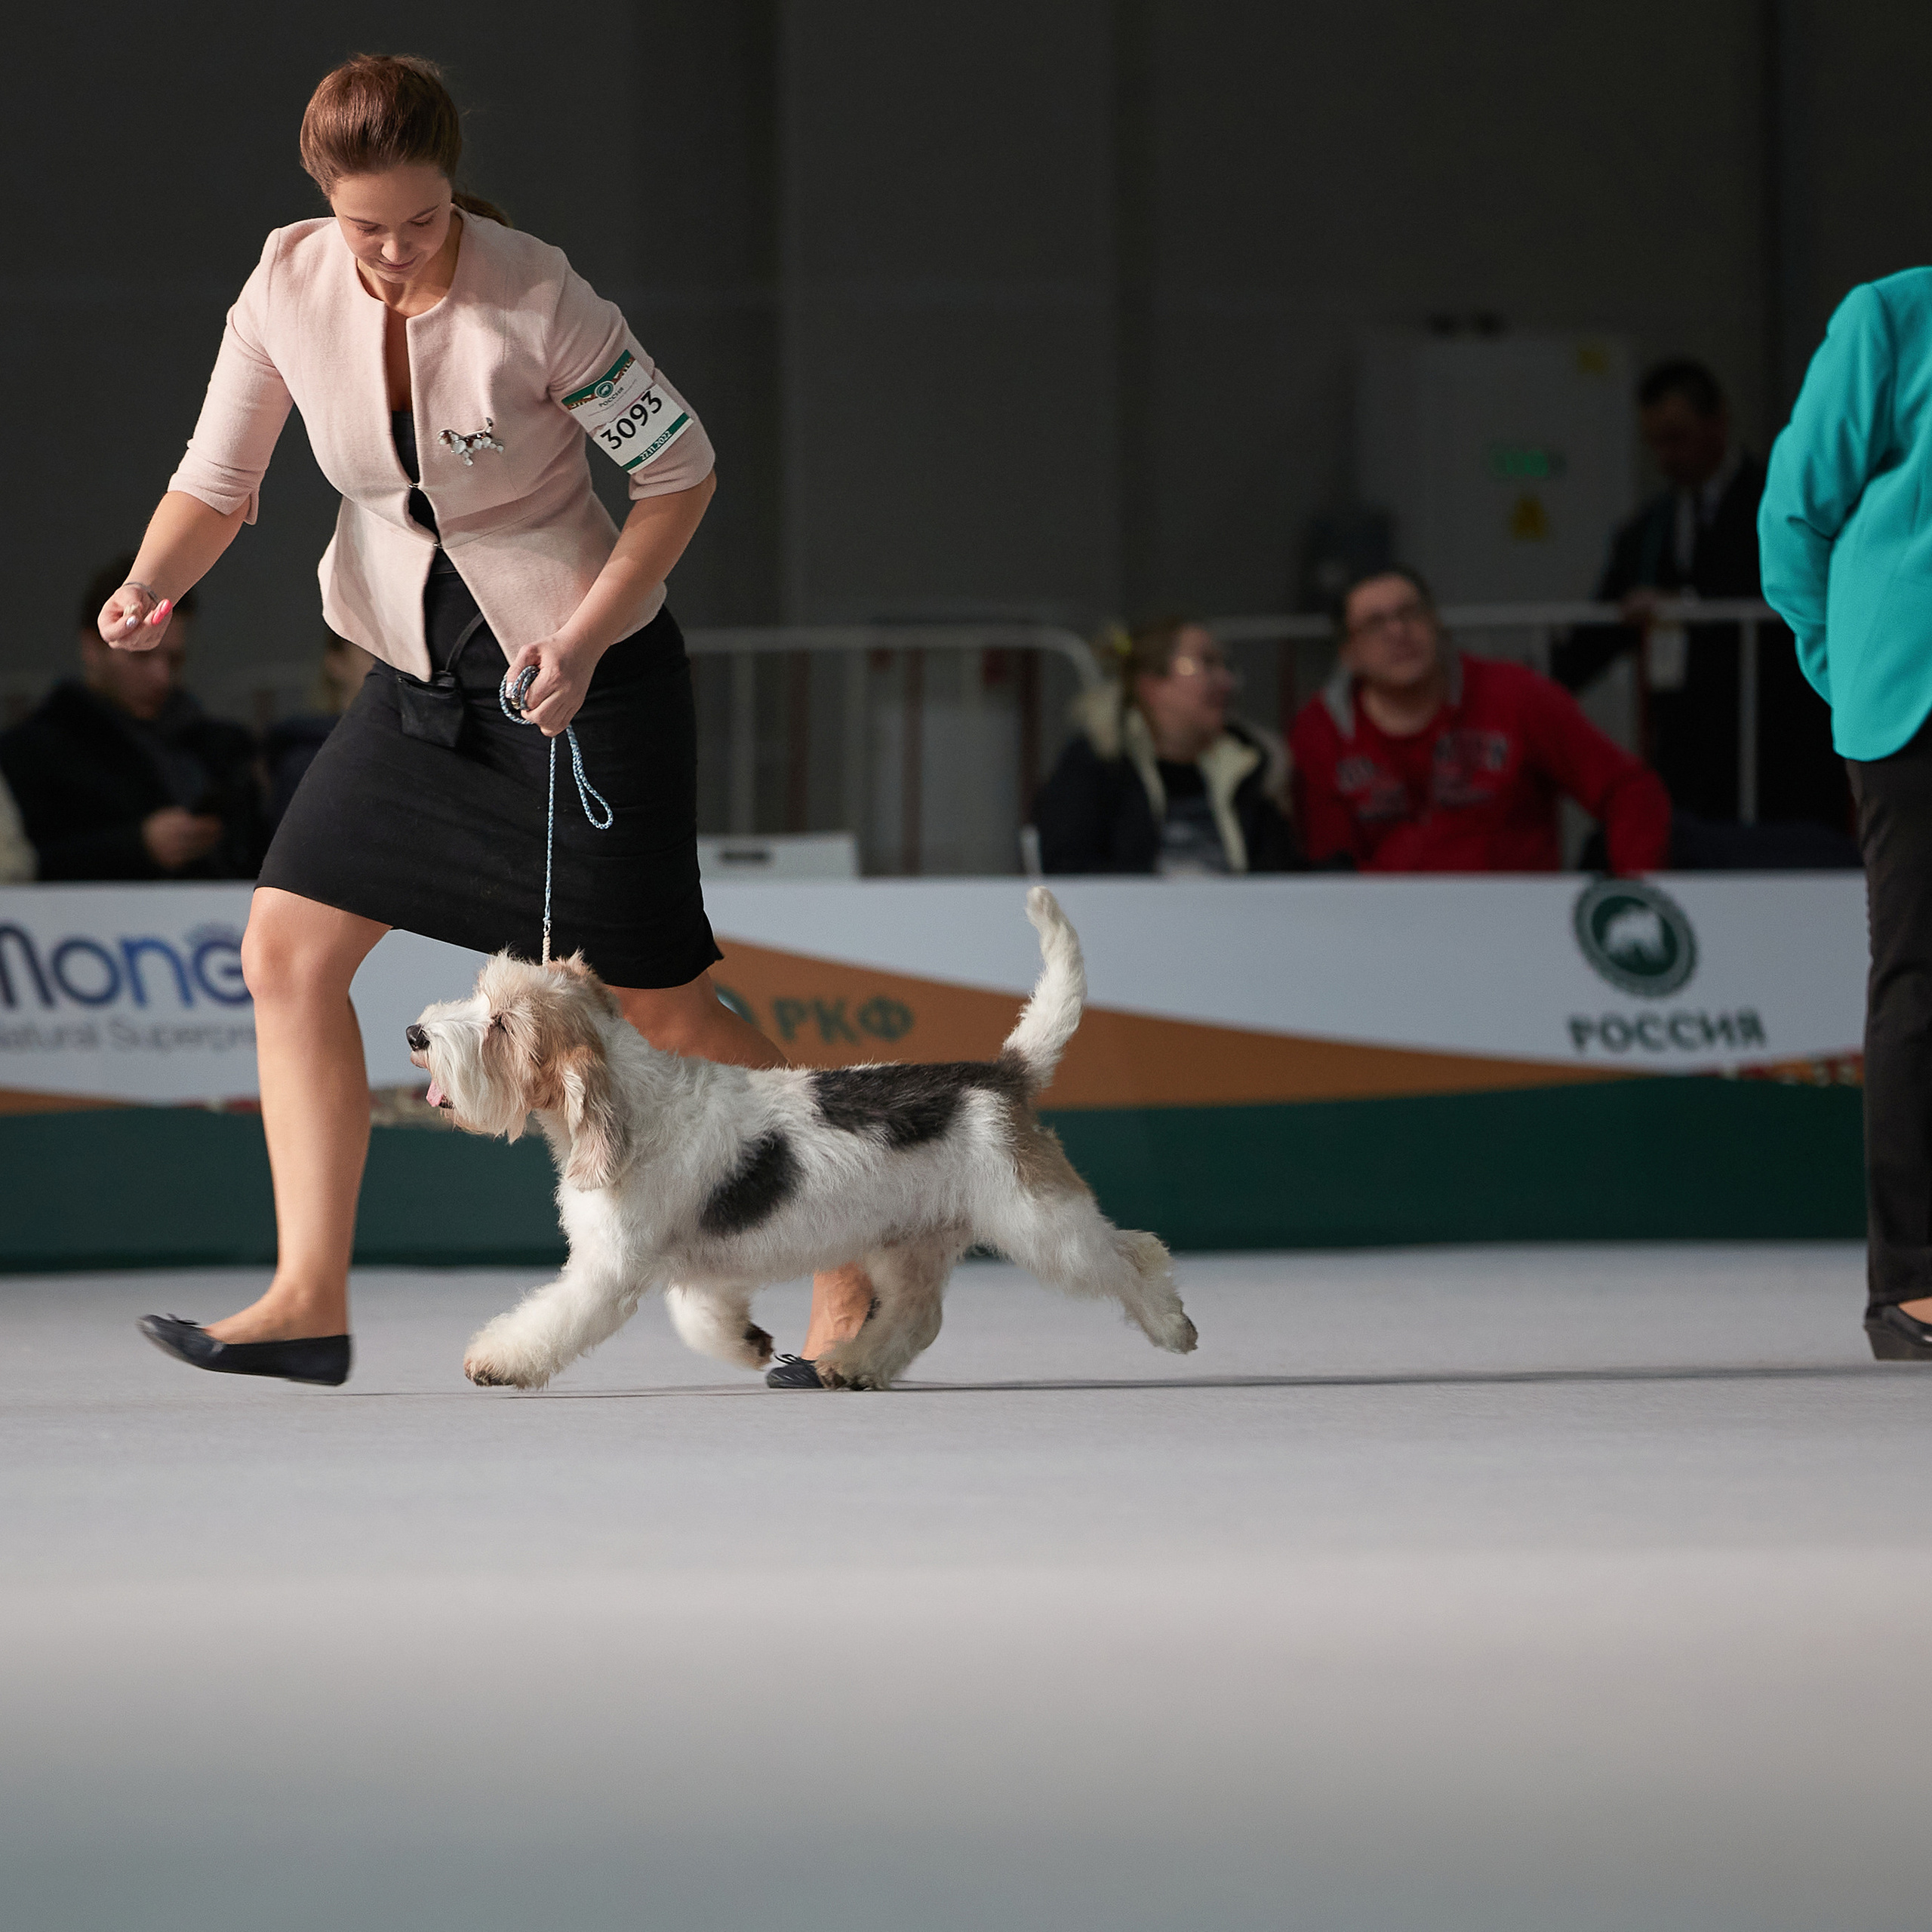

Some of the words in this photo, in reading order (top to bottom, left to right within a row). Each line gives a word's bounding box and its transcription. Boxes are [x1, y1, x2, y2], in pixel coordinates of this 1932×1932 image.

[600, 391, 662, 450] 3093
[771, 995, 915, 1046] РКФ
[1567, 1006, 1767, 1054] РОССИЯ
